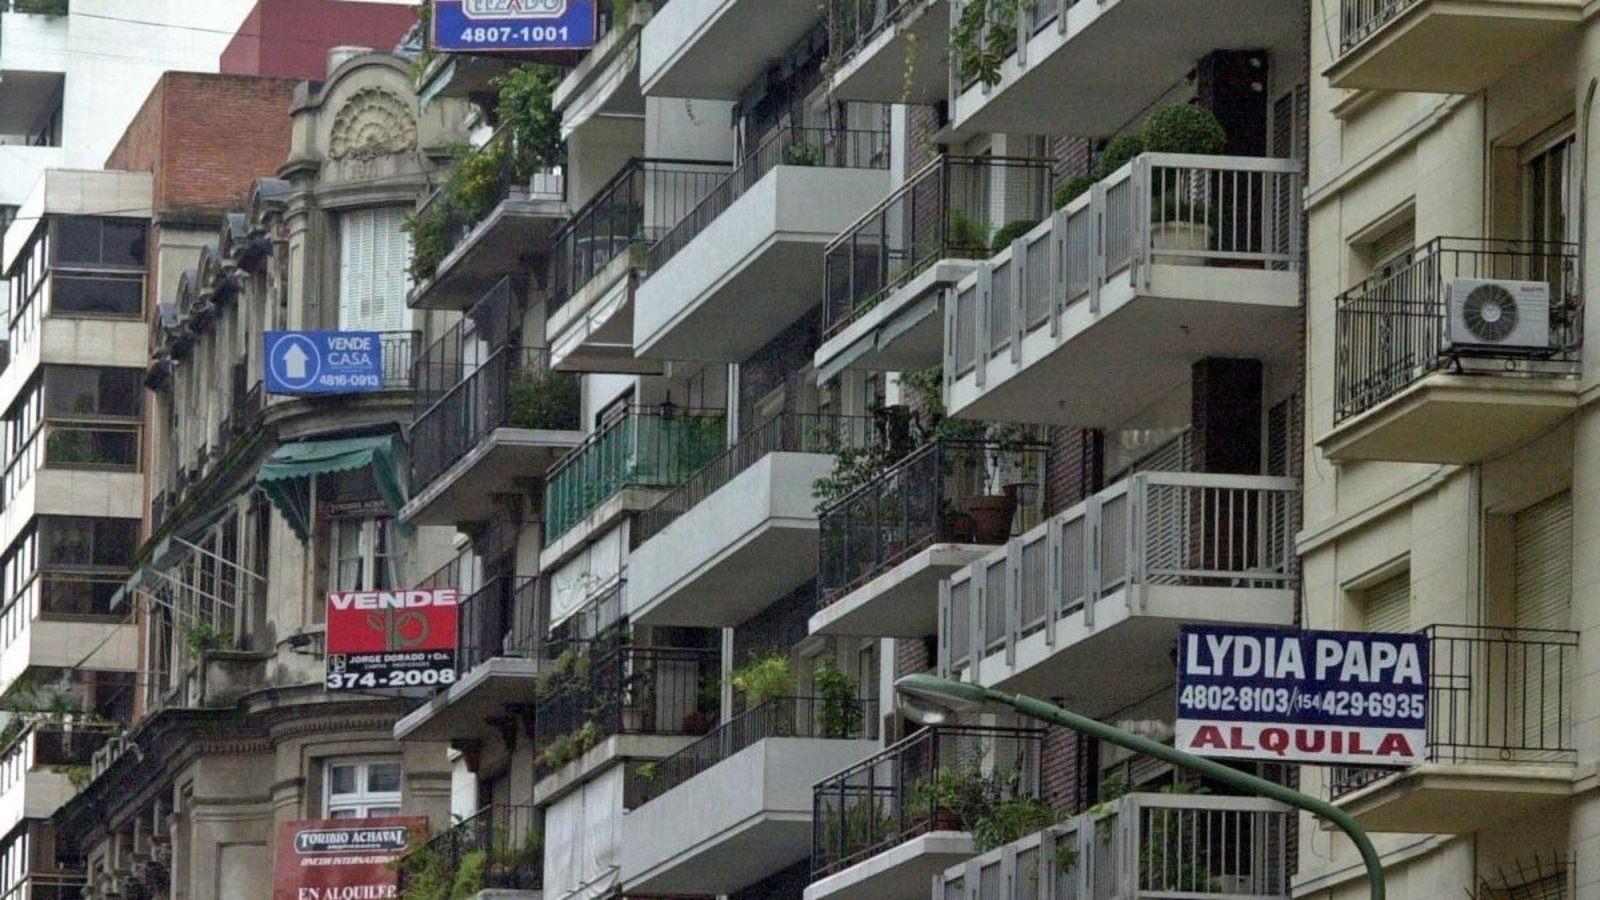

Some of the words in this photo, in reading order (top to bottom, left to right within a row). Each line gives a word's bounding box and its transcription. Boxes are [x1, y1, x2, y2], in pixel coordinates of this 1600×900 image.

[460, 26, 569, 43] 4807-1001
[327, 337, 371, 350] VENDE
[328, 352, 372, 366] CASA
[320, 374, 378, 386] 4816-0913
[330, 589, 457, 610] VENDE
[349, 655, 382, 664] JORGE
[384, 653, 425, 662] DORADO
[1186, 633, 1306, 680] LYDIA
[1315, 639, 1423, 684] PAPA
[328, 669, 455, 688] 374-2008
[1189, 725, 1415, 757] ALQUILA
[301, 832, 349, 848] TORIBIO
[351, 830, 404, 845] ACHAVAL
[298, 887, 320, 900] EN
